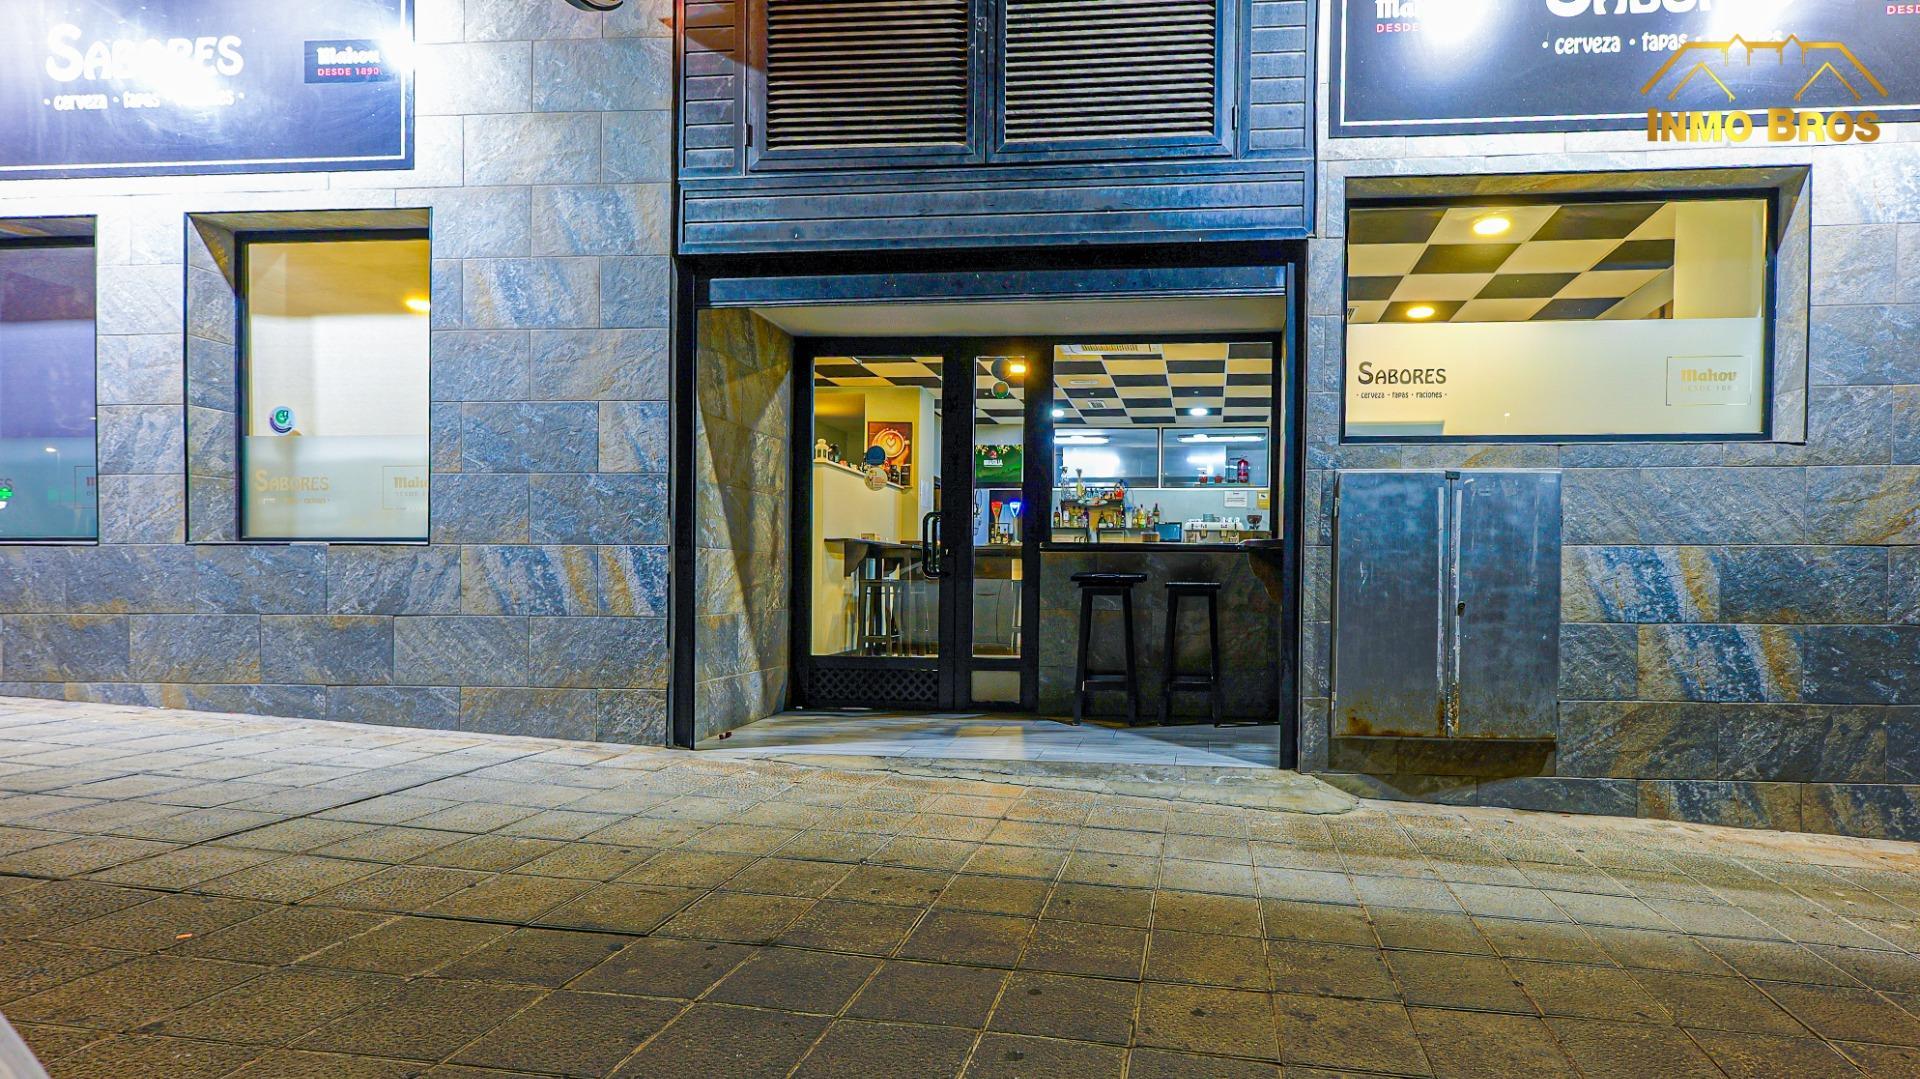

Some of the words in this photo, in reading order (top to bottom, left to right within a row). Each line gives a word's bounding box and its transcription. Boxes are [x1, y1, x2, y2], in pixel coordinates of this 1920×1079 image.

[1376, 22, 1420, 33] DESDE
[1554, 35, 1621, 55] cerveza
[1642, 32, 1688, 52] tapas
[317, 68, 352, 77] DESDE
[355, 67, 380, 76] 1890
[1357, 361, 1447, 385] SABORES
[1680, 367, 1737, 383] Mahou
[1360, 391, 1385, 399] cerveza
[1415, 391, 1443, 399] raciones
[255, 468, 330, 492] SABORES
